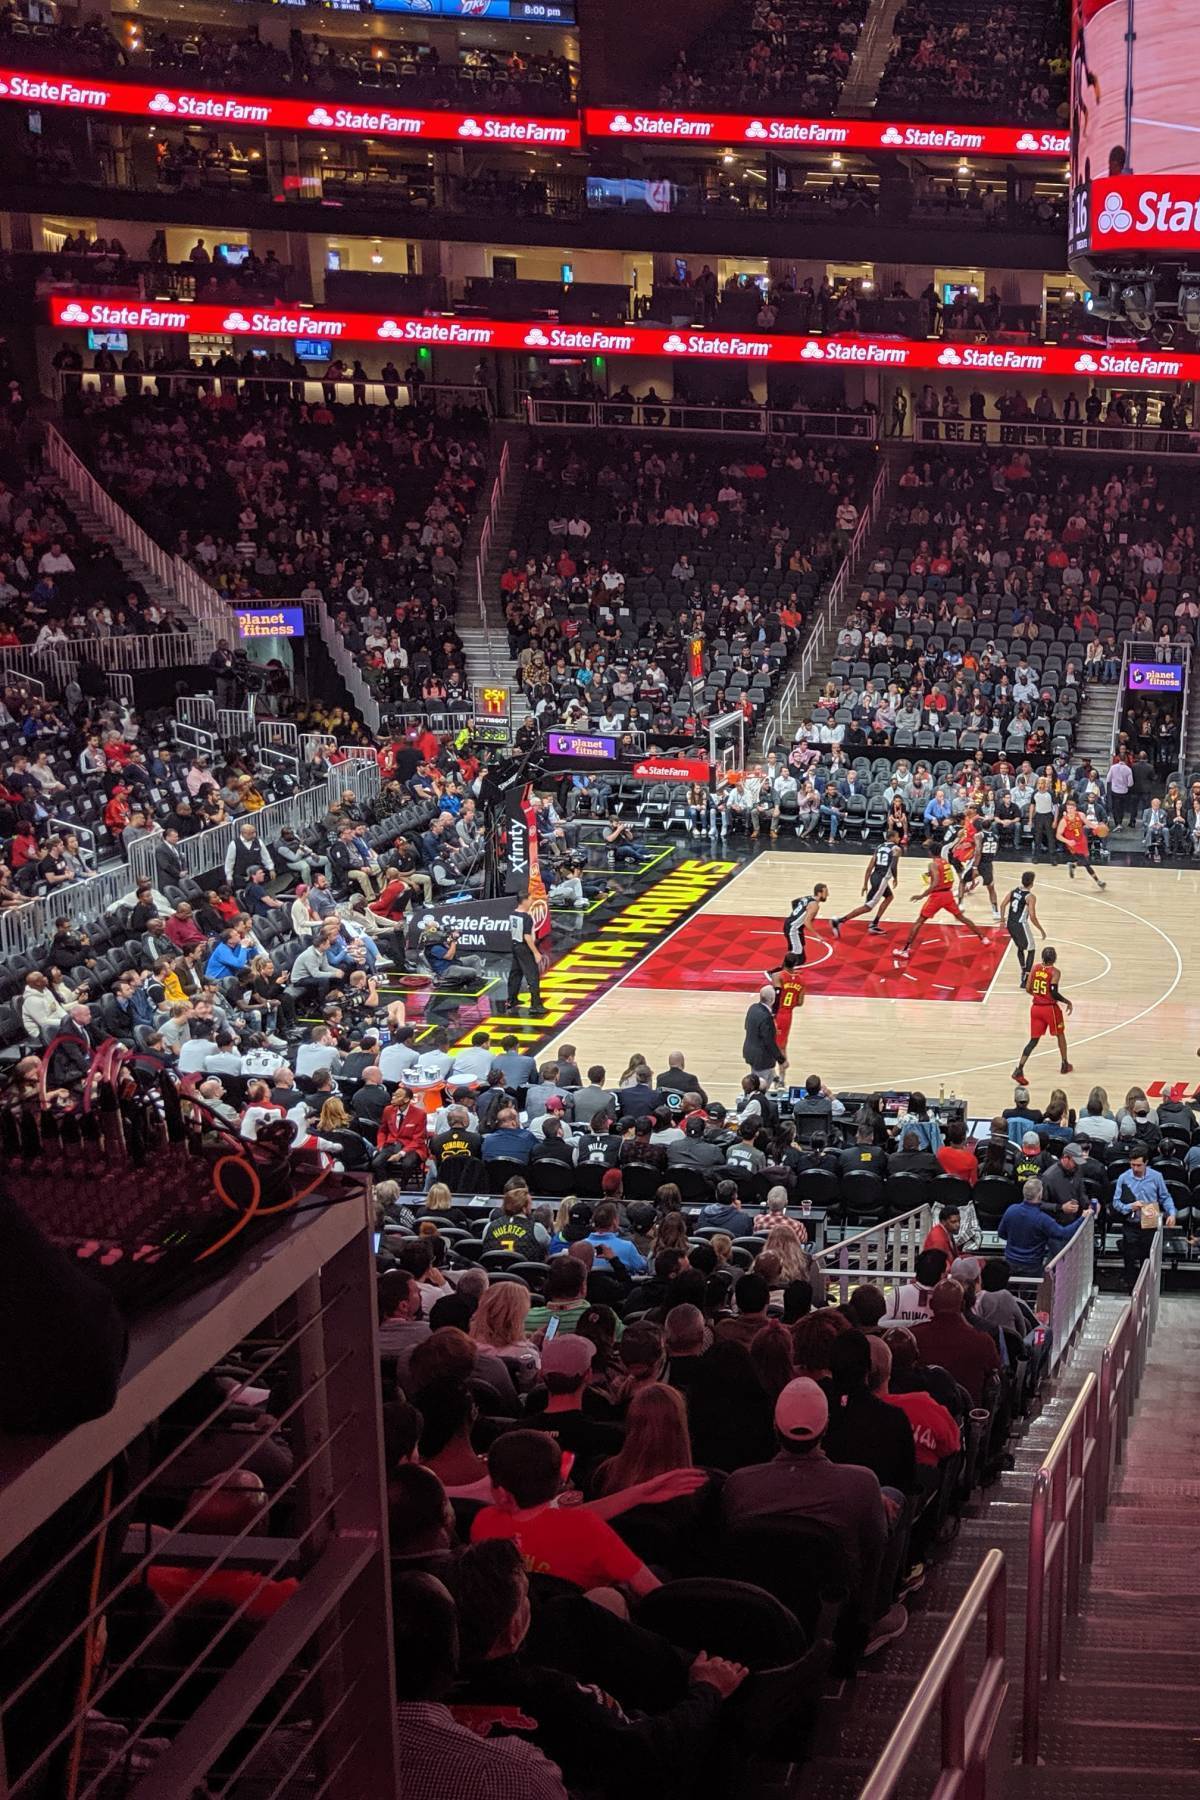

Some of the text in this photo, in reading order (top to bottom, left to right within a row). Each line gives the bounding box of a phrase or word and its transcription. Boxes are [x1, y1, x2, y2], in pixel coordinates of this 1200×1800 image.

[524, 4, 561, 18] 8:00 pm
[239, 612, 285, 625] planet
[243, 624, 295, 636] fitness
[1145, 670, 1175, 680] planet
[1149, 677, 1180, 686] fitness
[571, 737, 604, 750] planet
[575, 746, 609, 757] fitness
[508, 818, 528, 874] xfinity
[981, 841, 998, 854] 22
[876, 852, 889, 866] 12
[601, 860, 741, 934] HAWKS
[1033, 978, 1048, 995] 95
[783, 992, 794, 1007] 8
[587, 1142, 608, 1152] MILLS
[492, 1223, 527, 1239] HUERTER
